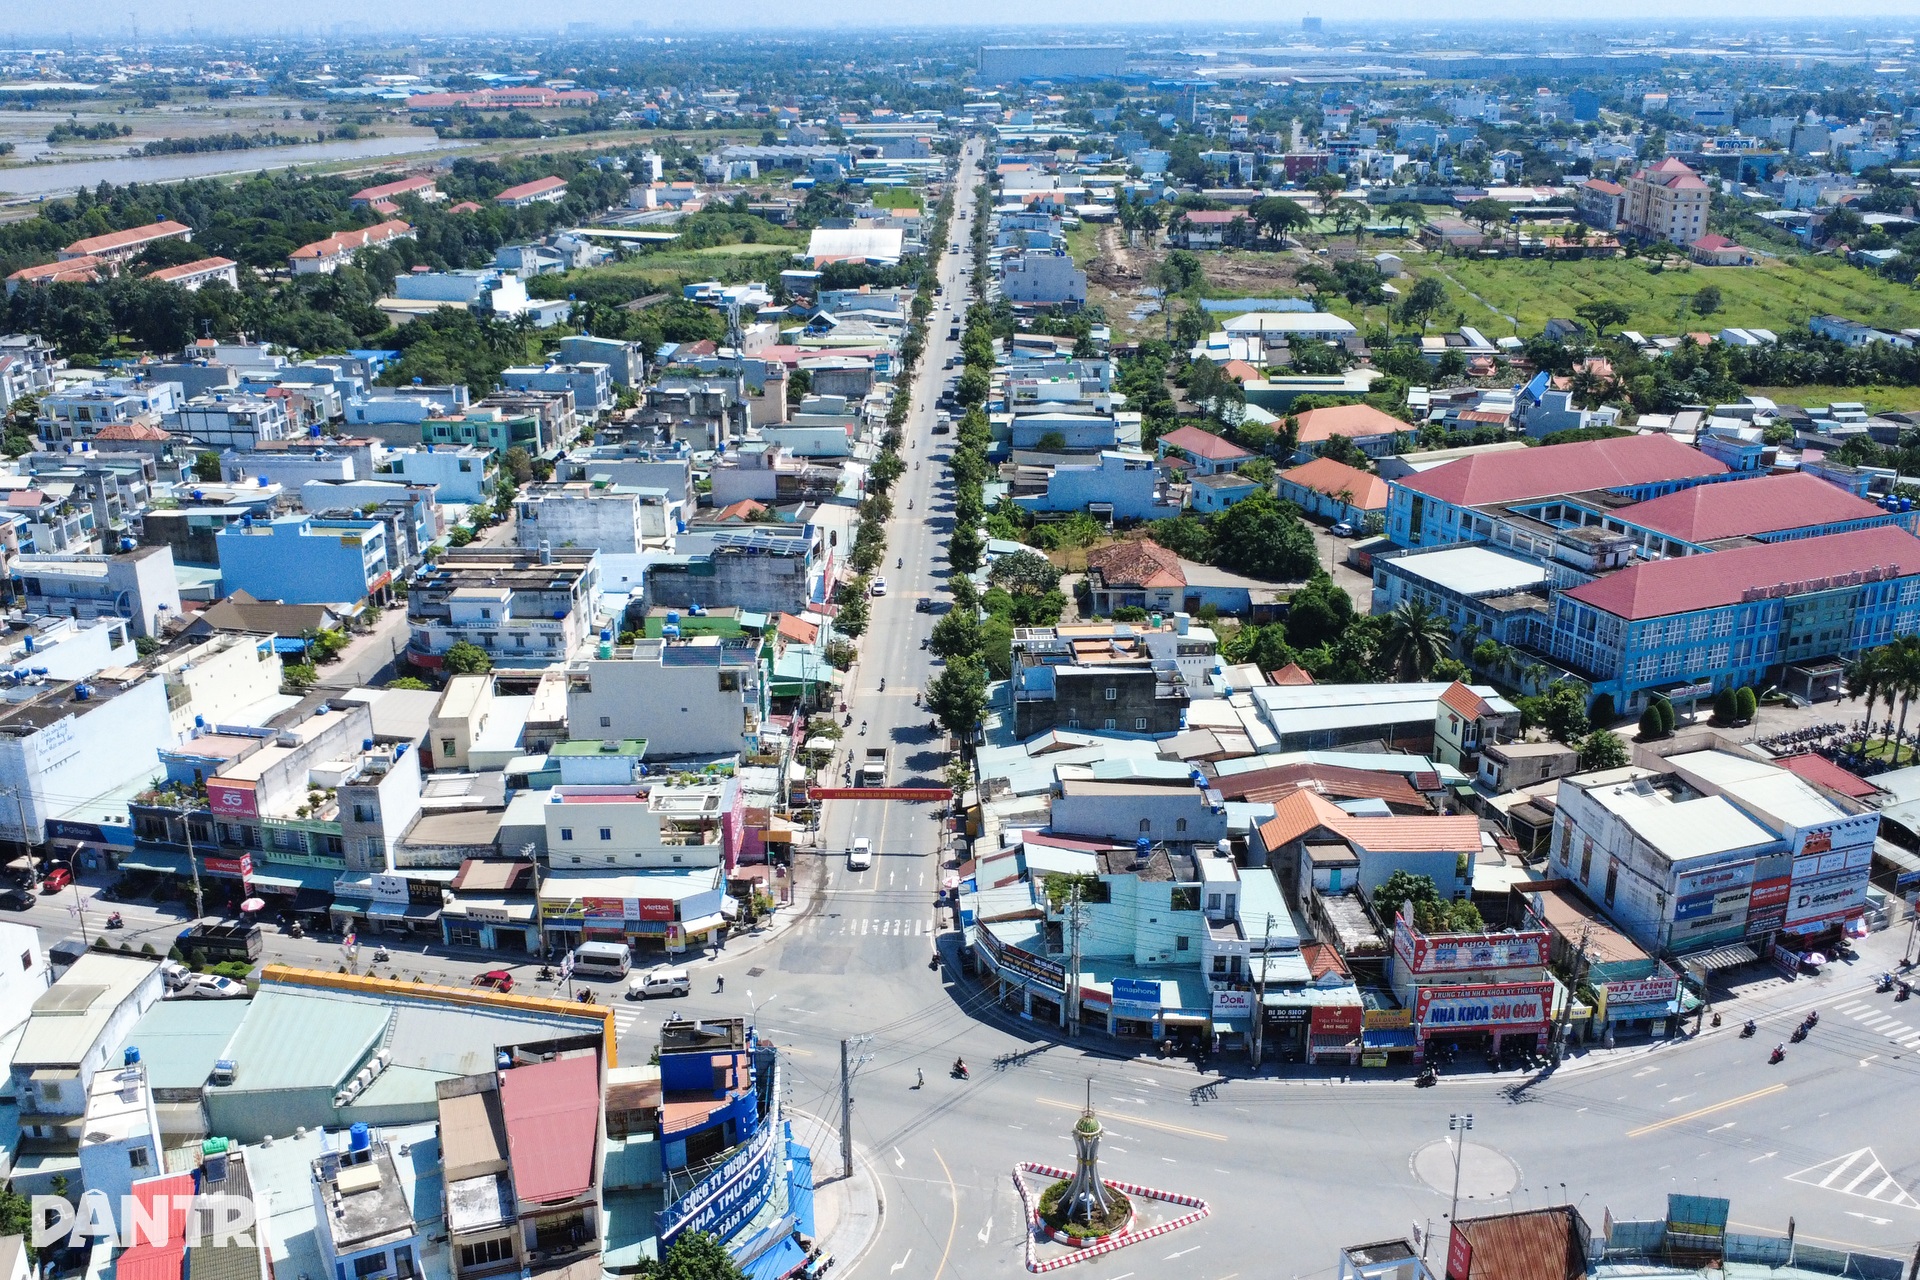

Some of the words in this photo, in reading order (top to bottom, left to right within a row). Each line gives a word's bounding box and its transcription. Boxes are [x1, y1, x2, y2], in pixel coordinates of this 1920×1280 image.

[222, 793, 242, 806] 5G
[64, 827, 92, 836] PGBank
[1117, 985, 1156, 996] vinaphone
[1431, 1007, 1455, 1022] NHA
[1457, 1006, 1489, 1021] KHOA
[1492, 1002, 1511, 1020] SÀI
[1513, 1000, 1537, 1018] GÒN
[710, 1171, 722, 1190] TY
[718, 1163, 761, 1211] THUỐC
